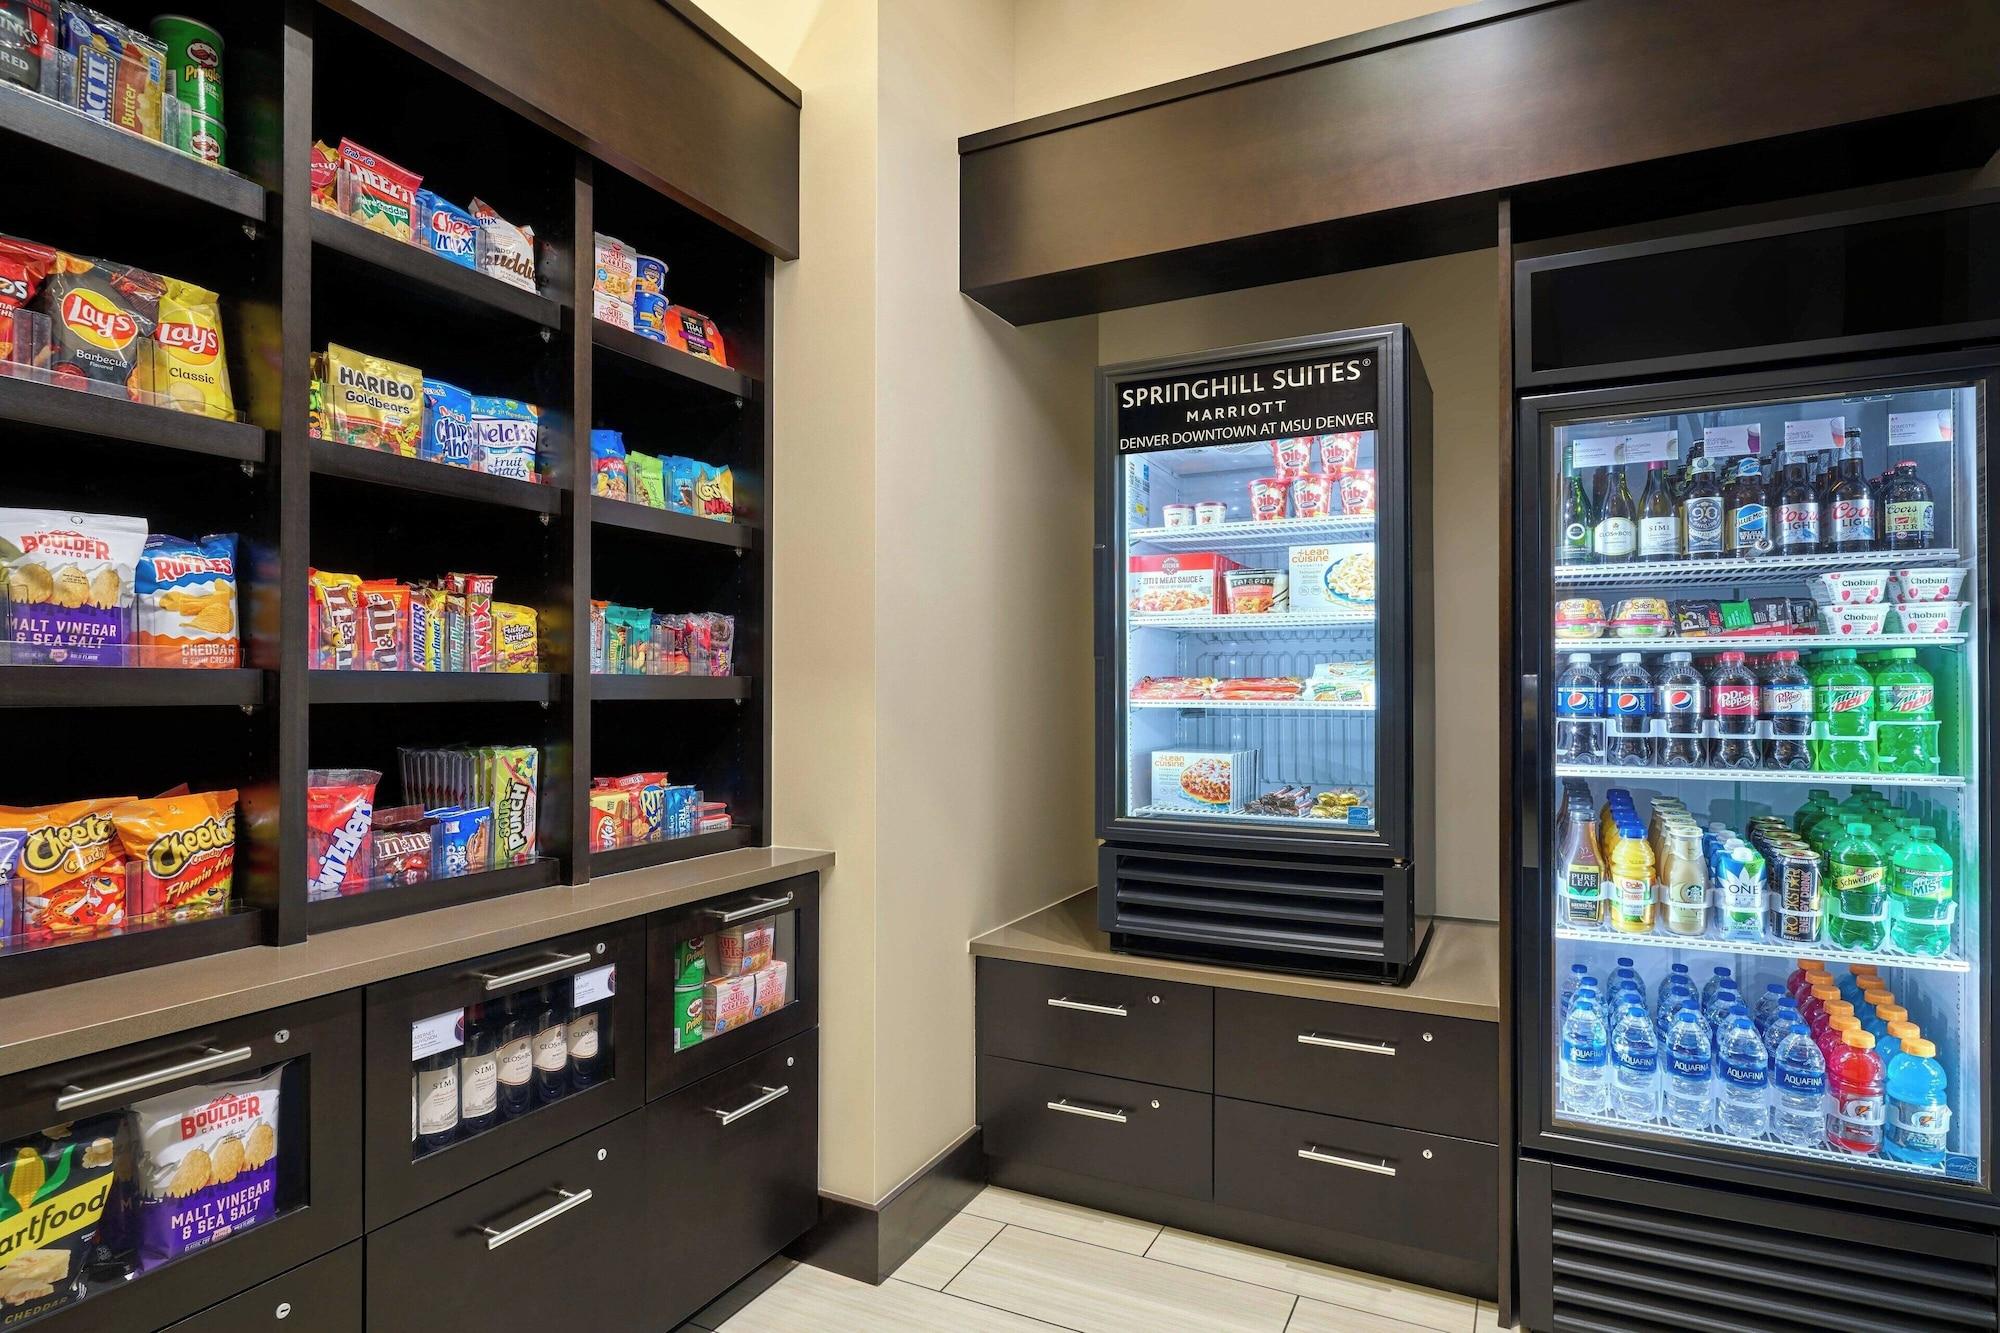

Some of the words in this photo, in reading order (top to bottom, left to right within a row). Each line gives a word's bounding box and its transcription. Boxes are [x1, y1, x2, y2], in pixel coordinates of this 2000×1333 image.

[121, 84, 138, 128] Butter
[343, 146, 359, 160] Grab
[432, 211, 477, 237] Chex
[436, 233, 475, 255] mix
[608, 248, 626, 262] CUP
[600, 253, 632, 273] NOODLES
[68, 295, 132, 338] Lay's
[683, 320, 703, 335] THAI
[159, 322, 217, 354] Lay's
[76, 349, 128, 369] Barbecue
[89, 360, 114, 371] Flavored
[169, 367, 215, 385] Classic
[340, 366, 414, 401] HARIBO
[1122, 372, 1264, 409] SPRINGHILL
[345, 390, 411, 415] Goldbears
[1186, 400, 1287, 422] MARRIOTT
[435, 418, 472, 445] Chips
[1119, 434, 1169, 450] DENVER
[1172, 424, 1257, 445] DOWNTOWN
[1260, 422, 1277, 434] AT
[1280, 418, 1312, 433] MSU
[1315, 411, 1374, 430] DENVER
[442, 439, 470, 459] Aho
[1281, 449, 1308, 461] Dibs
[495, 456, 523, 468] Fruit
[487, 464, 527, 478] Snacks
[1257, 493, 1281, 506] Dibs
[1692, 506, 1718, 520] 90
[1887, 504, 1917, 515] Coors
[20, 535, 112, 561] BOULDER
[45, 548, 90, 559] CANYON
[1291, 554, 1329, 563] cuisine
[154, 556, 233, 583] RUFFLES
[1177, 575, 1198, 584] SAUCE
[1842, 578, 1879, 587] Chobani
[1910, 577, 1949, 585] Chobani
[1634, 601, 1655, 610] Sabra
[1843, 613, 1879, 621] Chobani
[1908, 611, 1947, 620] Chobani
[7, 617, 49, 632] MALT
[56, 620, 117, 637] VINEGAR
[412, 602, 426, 665] SNICKERS
[502, 624, 530, 635] Fudge
[16, 632, 26, 644] &
[33, 633, 63, 647] SEA
[68, 634, 105, 649] SALT
[181, 643, 235, 656] CHEDDAR
[211, 655, 235, 665] CREAM
[1719, 692, 1753, 709] Pepper
[1730, 690, 1745, 699] Dr
[1775, 692, 1802, 704] Pepper
[508, 783, 528, 851] PUNCH
[191, 848, 224, 865] Crunchy
[166, 865, 212, 902] Flamin'
[1571, 873, 1596, 881] PURE
[1571, 880, 1597, 888] LEAF
[1840, 870, 1880, 887] Schweppes
[1625, 880, 1643, 889] Dole
[1913, 883, 1942, 896] MIST
[540, 1041, 557, 1050] CLOS
[502, 1053, 521, 1064] CLOS
[474, 1063, 495, 1076] SIMI
[1674, 1060, 1709, 1072] AQUAFINA
[1727, 1067, 1764, 1081] AQUAFINA
[1784, 1074, 1823, 1087] AQUAFINA
[432, 1078, 456, 1091] SIMI
[181, 1095, 262, 1141] BOULDER
[202, 1116, 244, 1134] CANYON
[171, 1203, 212, 1230] MALT
[217, 1179, 270, 1212] VINEGAR
[182, 1226, 192, 1240] &
[198, 1213, 225, 1235] SEA
[230, 1197, 261, 1222] SALT
[4, 1296, 68, 1326] CHEDDAR
